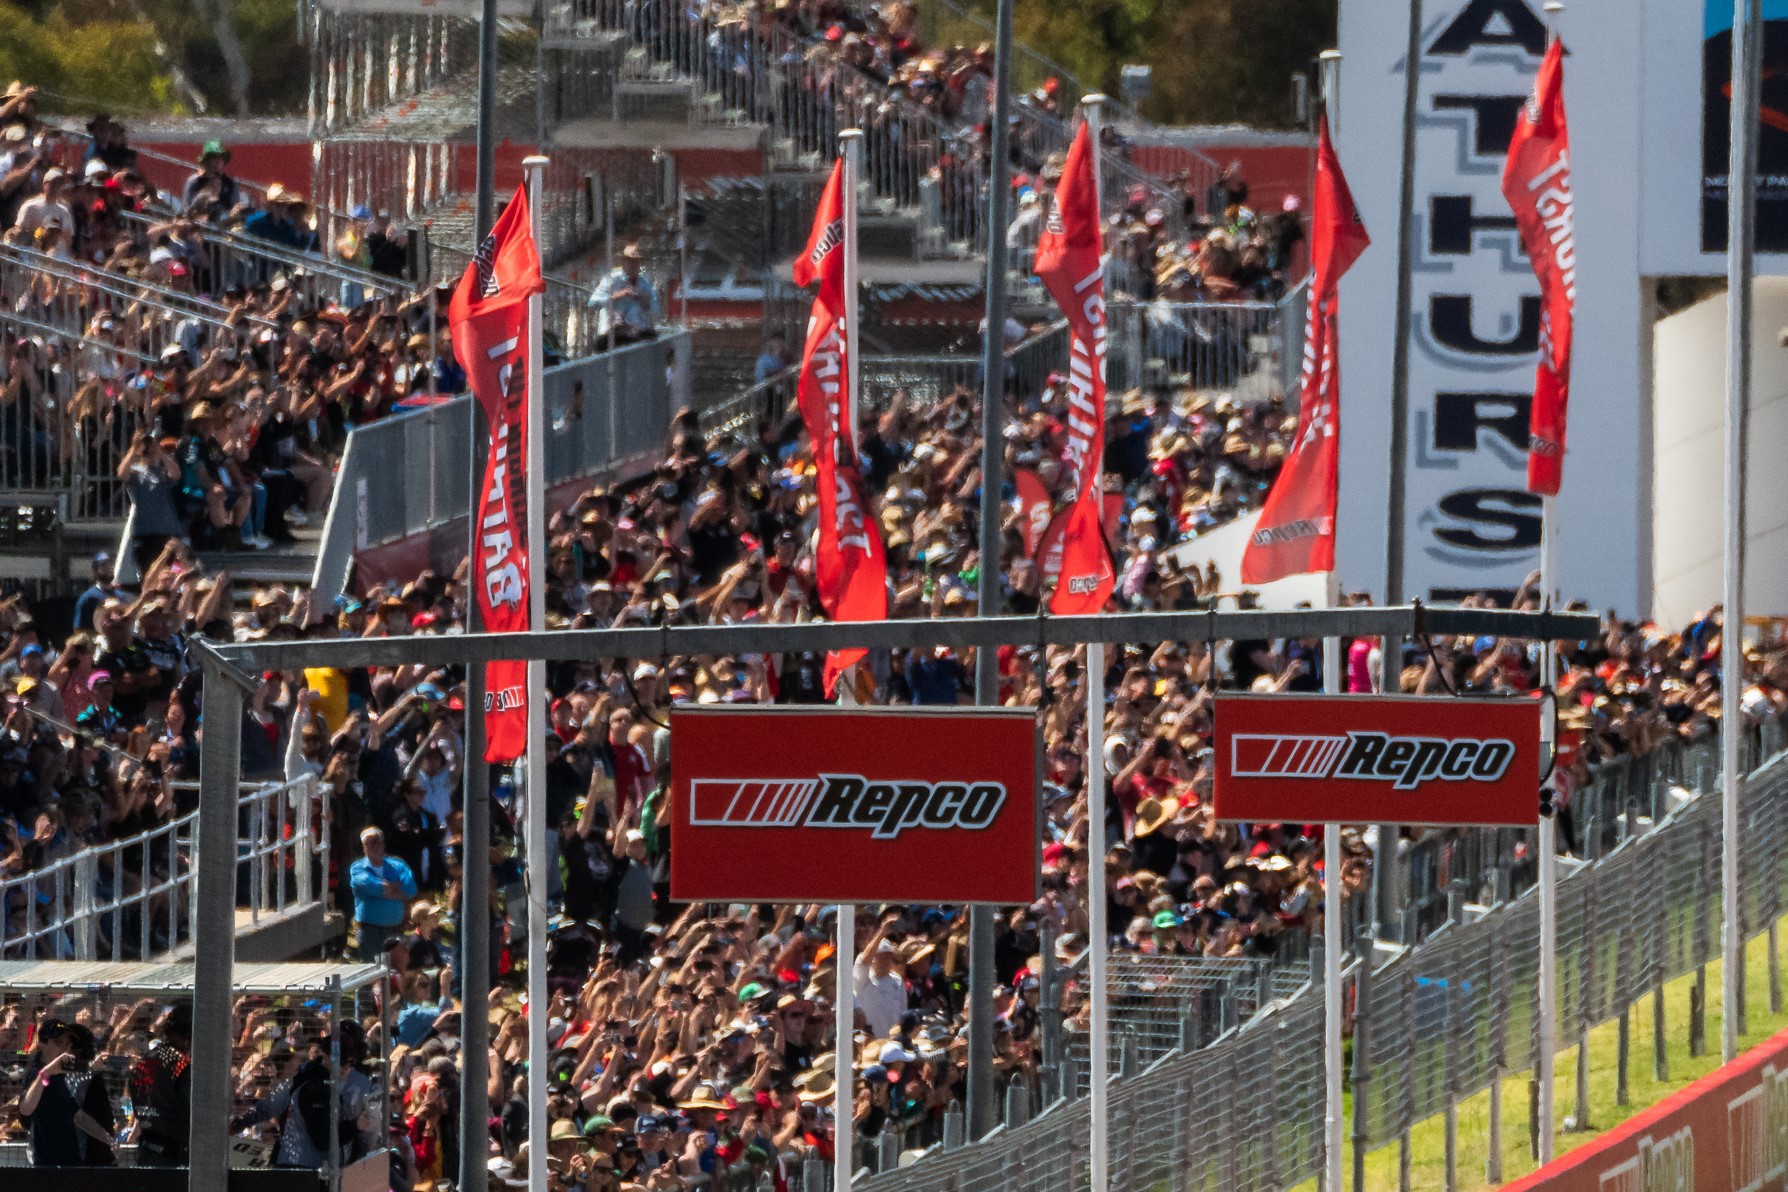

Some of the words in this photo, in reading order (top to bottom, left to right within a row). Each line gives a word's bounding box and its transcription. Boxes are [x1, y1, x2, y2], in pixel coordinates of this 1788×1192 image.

[1424, 0, 1570, 602] ATHURS
[1334, 730, 1517, 790] Repco
[803, 772, 1008, 839] Repco
